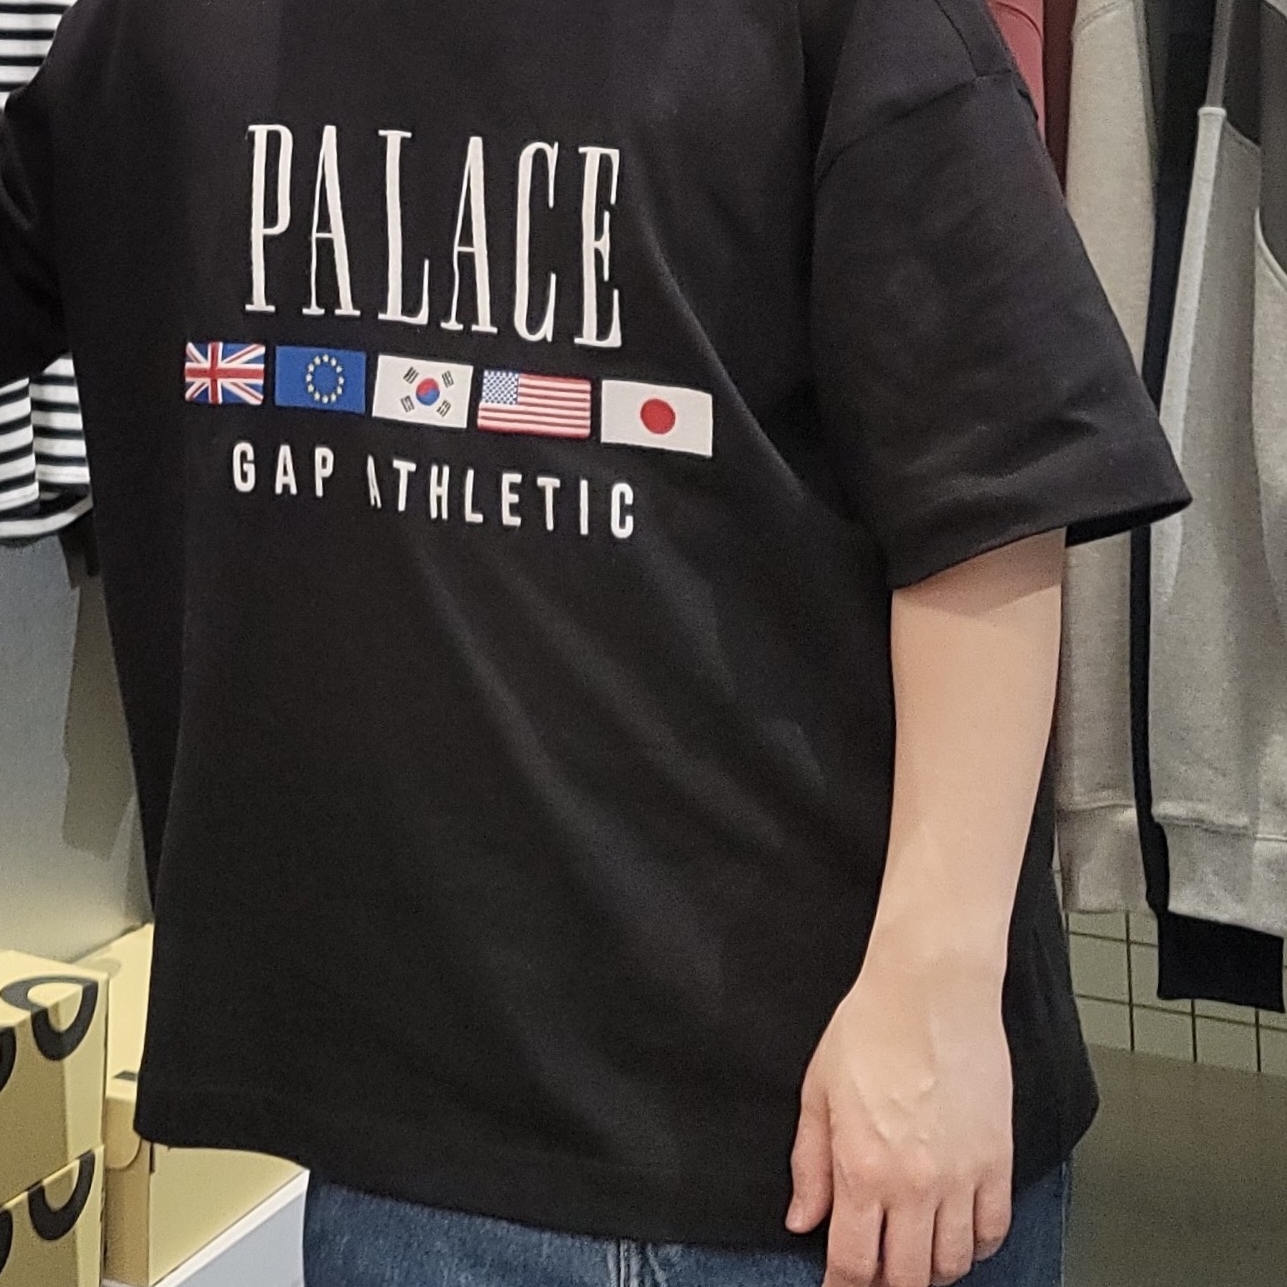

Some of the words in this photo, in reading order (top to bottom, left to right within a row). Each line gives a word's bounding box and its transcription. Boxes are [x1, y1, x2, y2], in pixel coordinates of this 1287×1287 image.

[244, 123, 624, 349] PALACE
[231, 441, 335, 499] GAP
[366, 453, 635, 540] ATHLETIC
